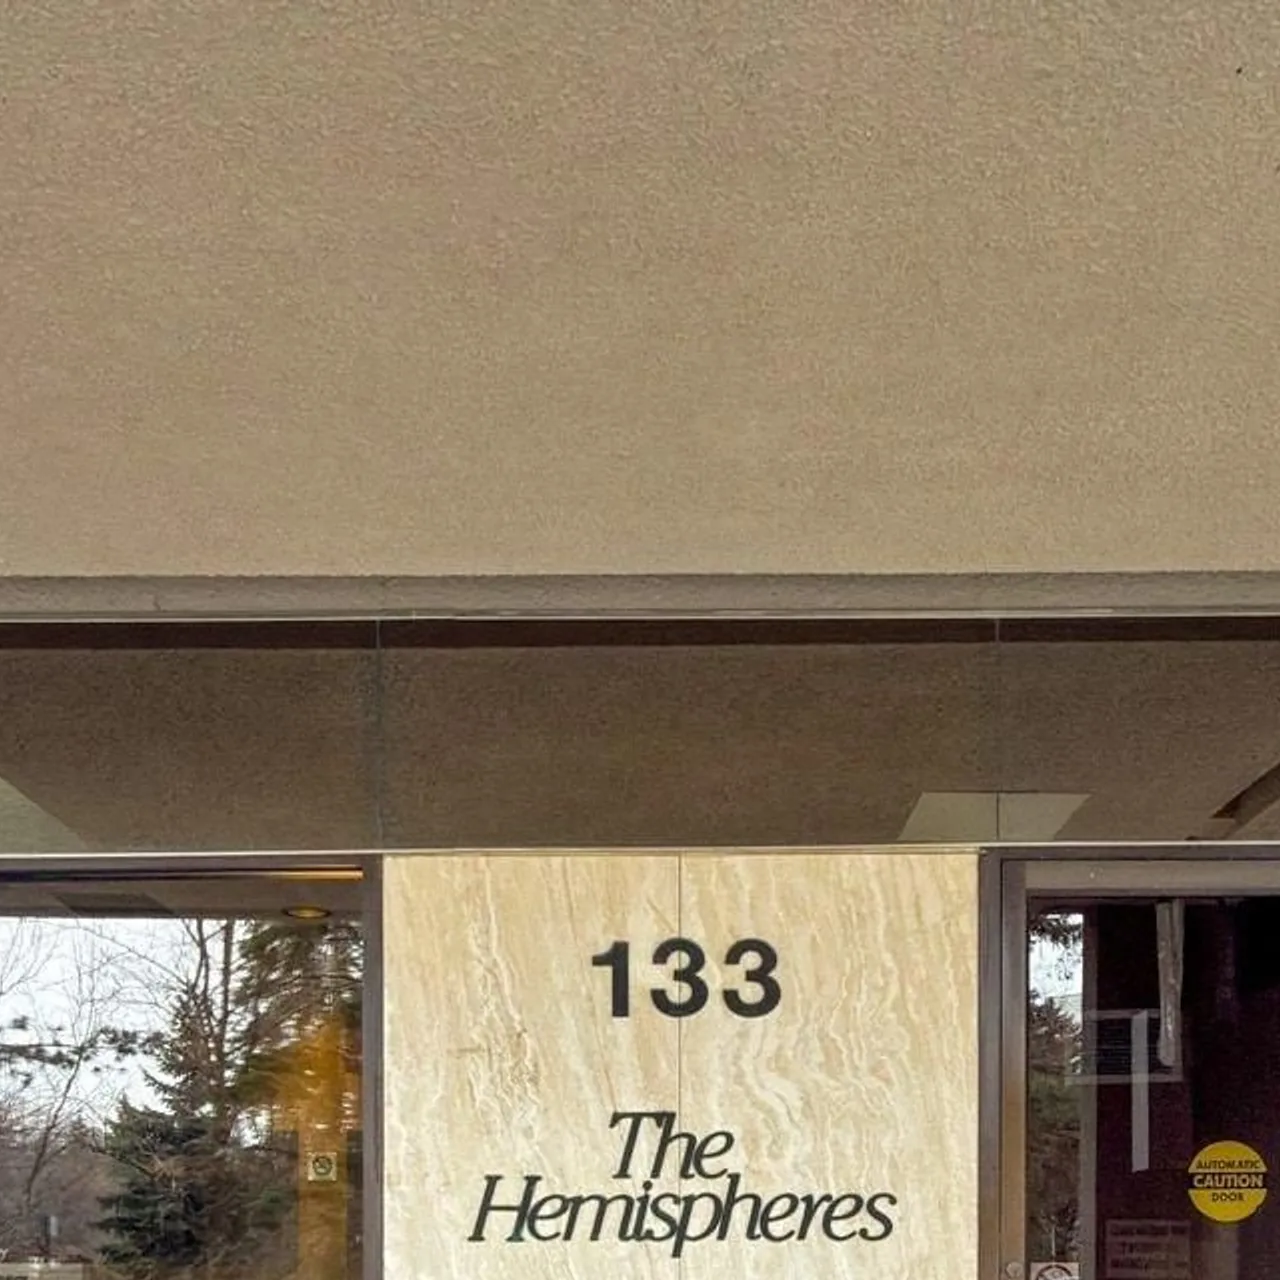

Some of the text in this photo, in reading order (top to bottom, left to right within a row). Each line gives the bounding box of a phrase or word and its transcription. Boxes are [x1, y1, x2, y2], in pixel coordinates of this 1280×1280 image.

[592, 938, 781, 1018] 133
[609, 1111, 734, 1179] The
[1195, 1159, 1261, 1169] AUTOMATIC
[1193, 1173, 1264, 1187] CAUTION
[1211, 1191, 1245, 1202] DOOR
[467, 1173, 897, 1258] Hemispheres
